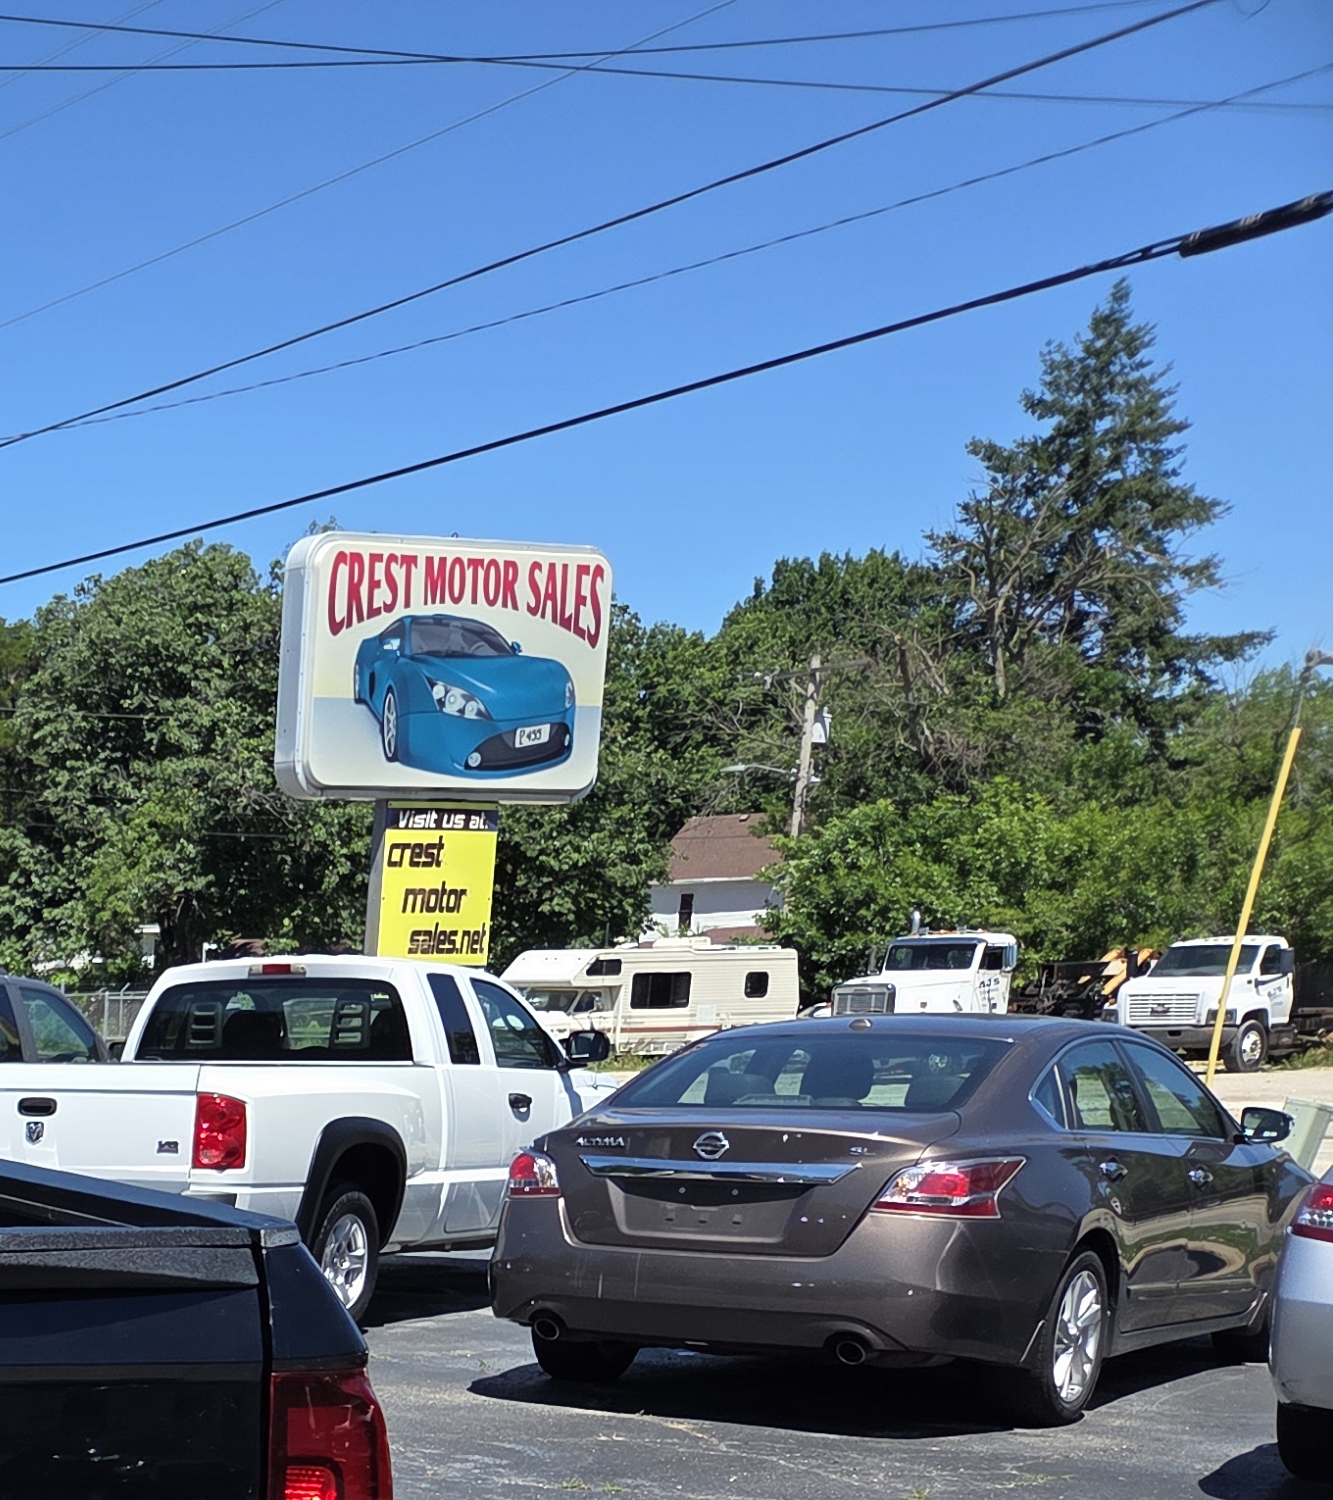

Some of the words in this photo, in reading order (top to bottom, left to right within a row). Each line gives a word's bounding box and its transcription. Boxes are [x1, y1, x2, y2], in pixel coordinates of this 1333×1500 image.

[327, 550, 418, 636] CREST
[423, 555, 519, 613] MOTOR
[526, 562, 605, 649] SALES
[398, 810, 438, 829] Visit
[442, 812, 466, 829] us
[387, 835, 445, 868] crest
[401, 880, 468, 914] motor
[407, 922, 487, 955] sales.net
